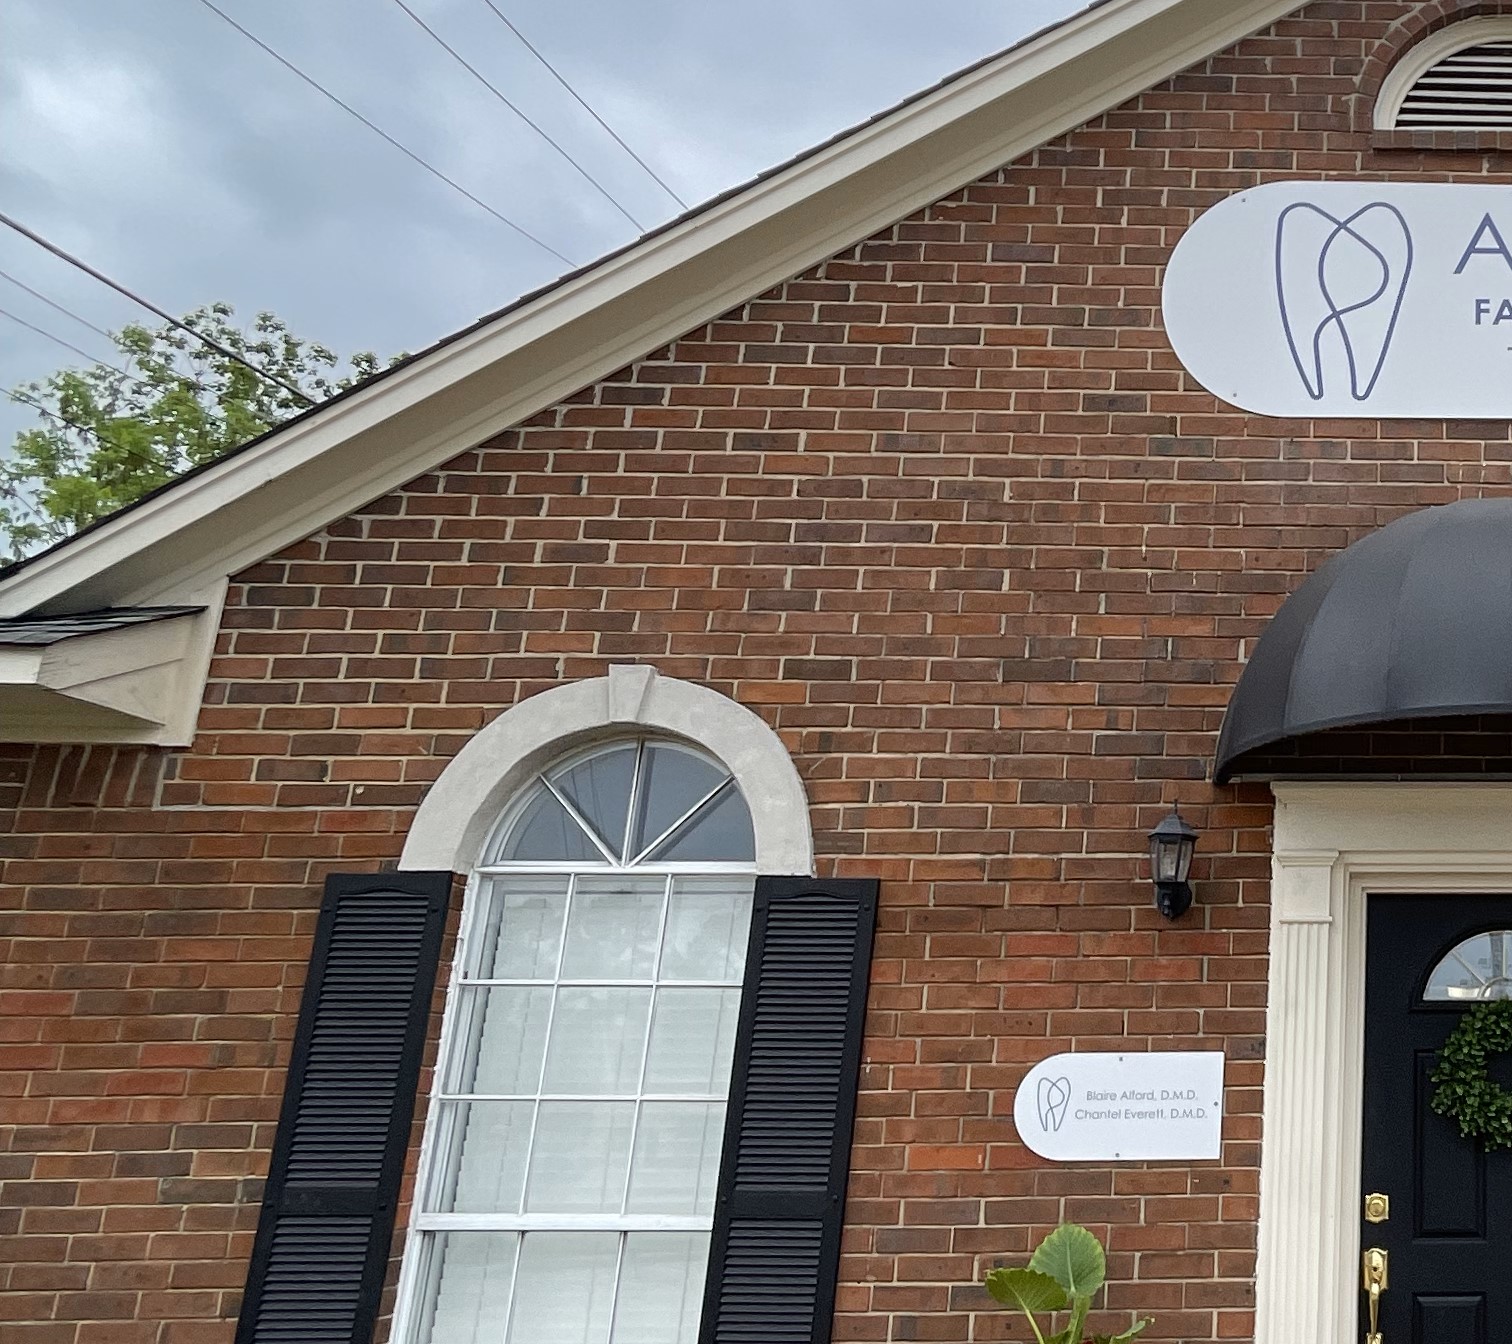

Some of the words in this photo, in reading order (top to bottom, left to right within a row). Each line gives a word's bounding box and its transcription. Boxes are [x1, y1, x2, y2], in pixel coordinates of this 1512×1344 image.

[1086, 1090, 1118, 1102] Blaire
[1120, 1089, 1157, 1103] Alford,
[1160, 1089, 1199, 1102] D.M.D.
[1074, 1108, 1122, 1121] Chantel
[1170, 1107, 1208, 1120] D.M.D.
